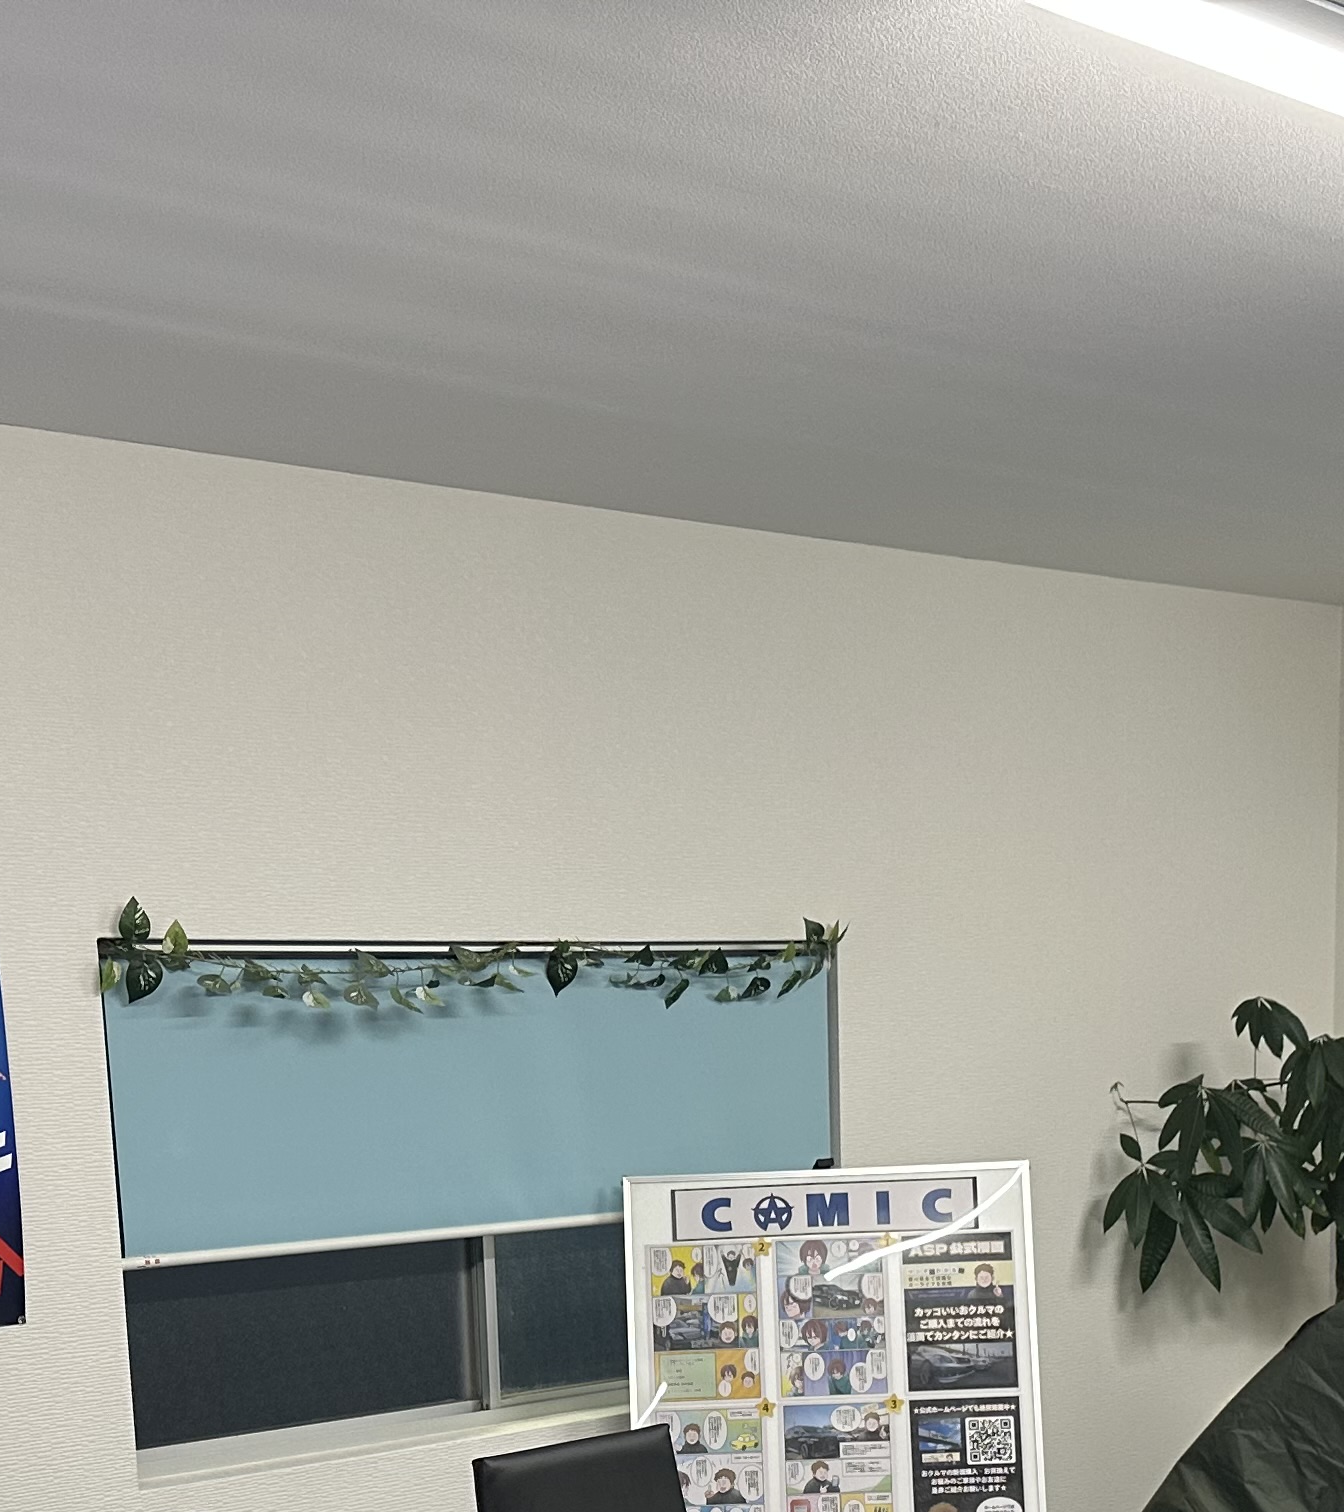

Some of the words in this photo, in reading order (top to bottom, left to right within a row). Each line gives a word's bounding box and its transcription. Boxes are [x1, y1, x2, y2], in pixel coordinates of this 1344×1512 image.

[758, 1242, 766, 1253] 2
[762, 1403, 770, 1414] 4
[890, 1399, 897, 1410] 3
